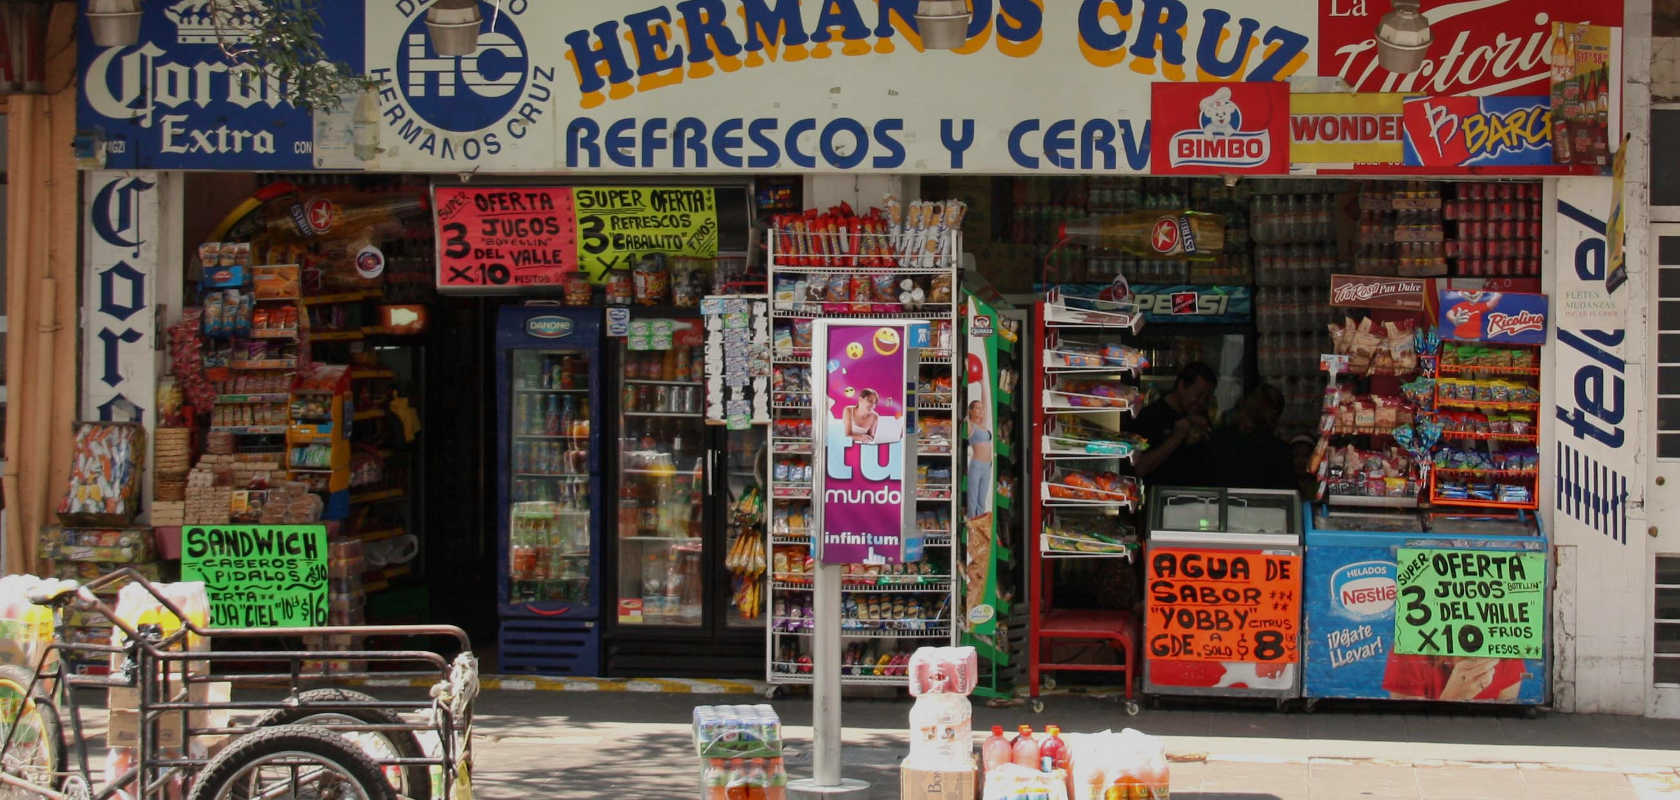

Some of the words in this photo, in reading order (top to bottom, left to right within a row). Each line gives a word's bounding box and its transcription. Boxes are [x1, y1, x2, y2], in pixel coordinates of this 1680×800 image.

[1078, 0, 1309, 82] CRUZ
[1334, 12, 1552, 92] Vctori
[370, 66, 502, 160] HERMANOS
[507, 65, 556, 139] CRUZ
[160, 114, 276, 154] Extra
[1291, 115, 1403, 141] WONDE
[1462, 107, 1552, 154] BARC
[566, 117, 906, 168] REFRESCOS
[940, 119, 975, 169] Y
[1008, 119, 1152, 170] CERV
[1177, 136, 1264, 160] BIMBO
[438, 192, 472, 221] SUPER
[474, 191, 555, 212] OFERTA
[576, 190, 646, 209] SUPER
[650, 190, 706, 214] OFERTA
[443, 222, 472, 260] 3
[481, 216, 561, 238] JUGOS
[579, 215, 610, 255] 3
[610, 214, 693, 232] REFRESCOS
[474, 248, 505, 260] DEL
[509, 249, 563, 266] VALLE
[1135, 294, 1229, 316] PESI
[529, 320, 571, 331] DANONE
[1488, 311, 1545, 332] Ricolino
[825, 397, 903, 482] tu
[825, 485, 902, 505] mundo
[187, 528, 318, 560] SANDWICH
[824, 532, 899, 545] infinitum
[202, 558, 298, 569] CASEROS
[1152, 553, 1250, 580] AGUA
[1265, 558, 1292, 581] DE
[1346, 566, 1387, 578] HELADOS
[1398, 552, 1429, 586] SUPER
[1432, 552, 1526, 581] OFERTA
[207, 591, 257, 602] ERTA
[1150, 580, 1262, 605] SABOR
[1343, 584, 1397, 606] Nestlé
[1402, 585, 1432, 626] 3
[1434, 580, 1505, 599] JUGOS
[301, 592, 327, 627] $16
[1248, 618, 1293, 630] CITRUS
[1487, 626, 1533, 639] FRIOS
[1203, 644, 1233, 656] SOLO
[1488, 644, 1520, 655] PESOS
